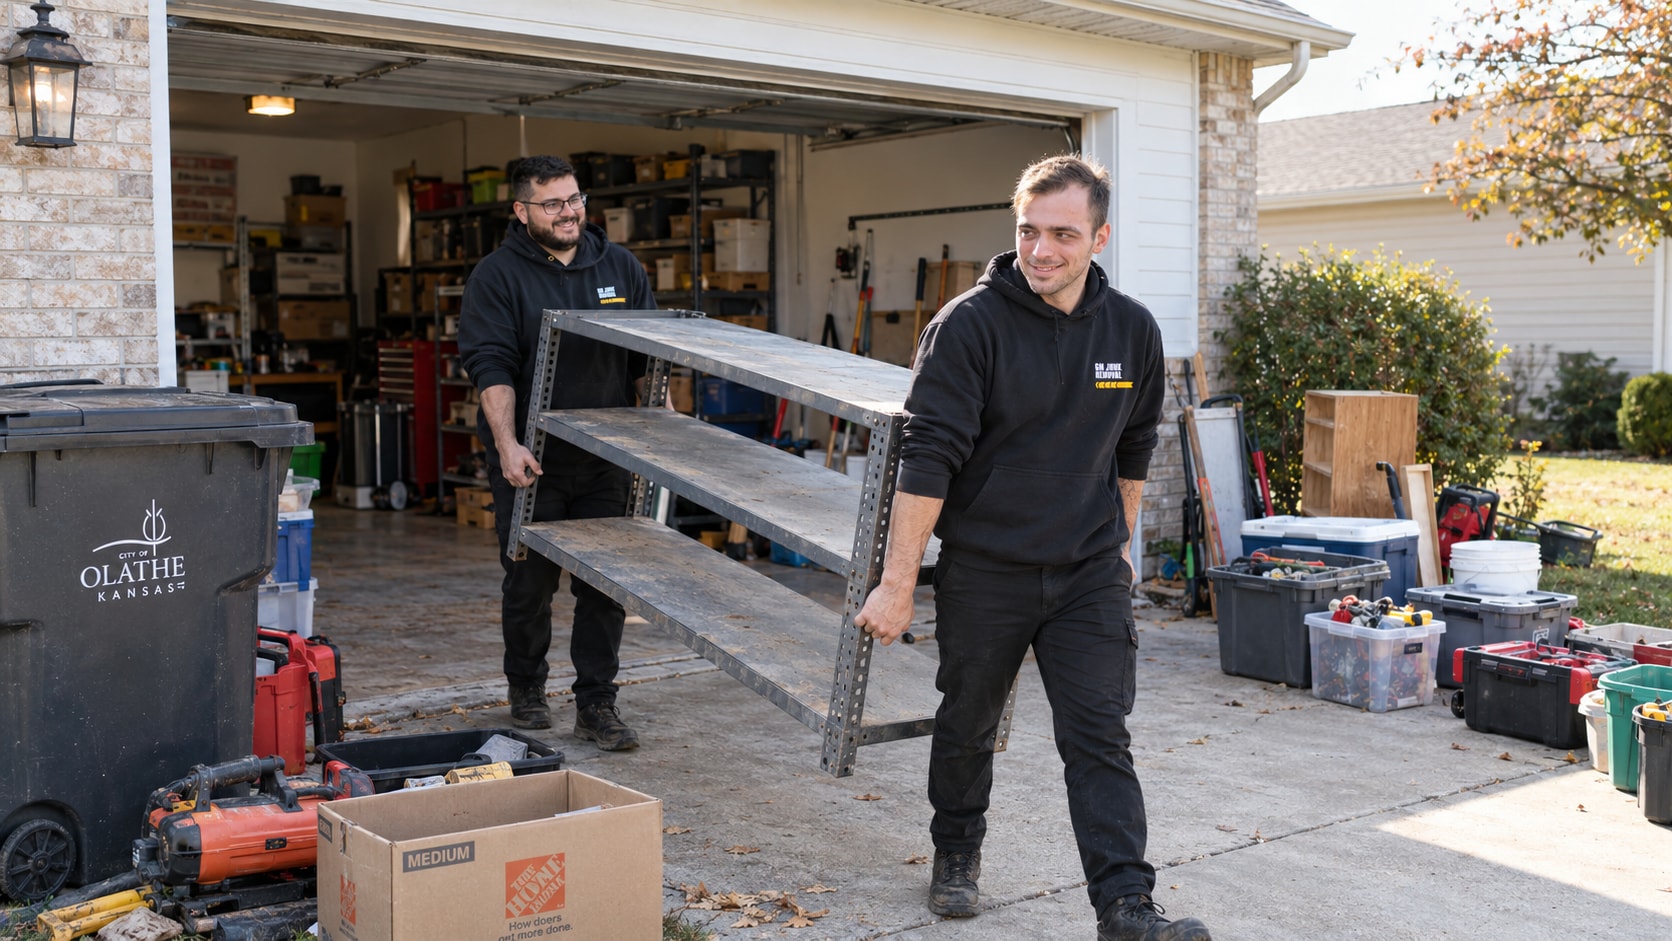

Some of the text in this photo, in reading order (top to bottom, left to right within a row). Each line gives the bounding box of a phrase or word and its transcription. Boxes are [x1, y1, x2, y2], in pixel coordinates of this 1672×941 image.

[80, 556, 186, 588] OLATHE
[98, 583, 175, 602] KANSAS
[408, 846, 470, 868] MEDIUM
[509, 915, 562, 931] How doers
[517, 929, 544, 939] more
[545, 923, 573, 934] done.
